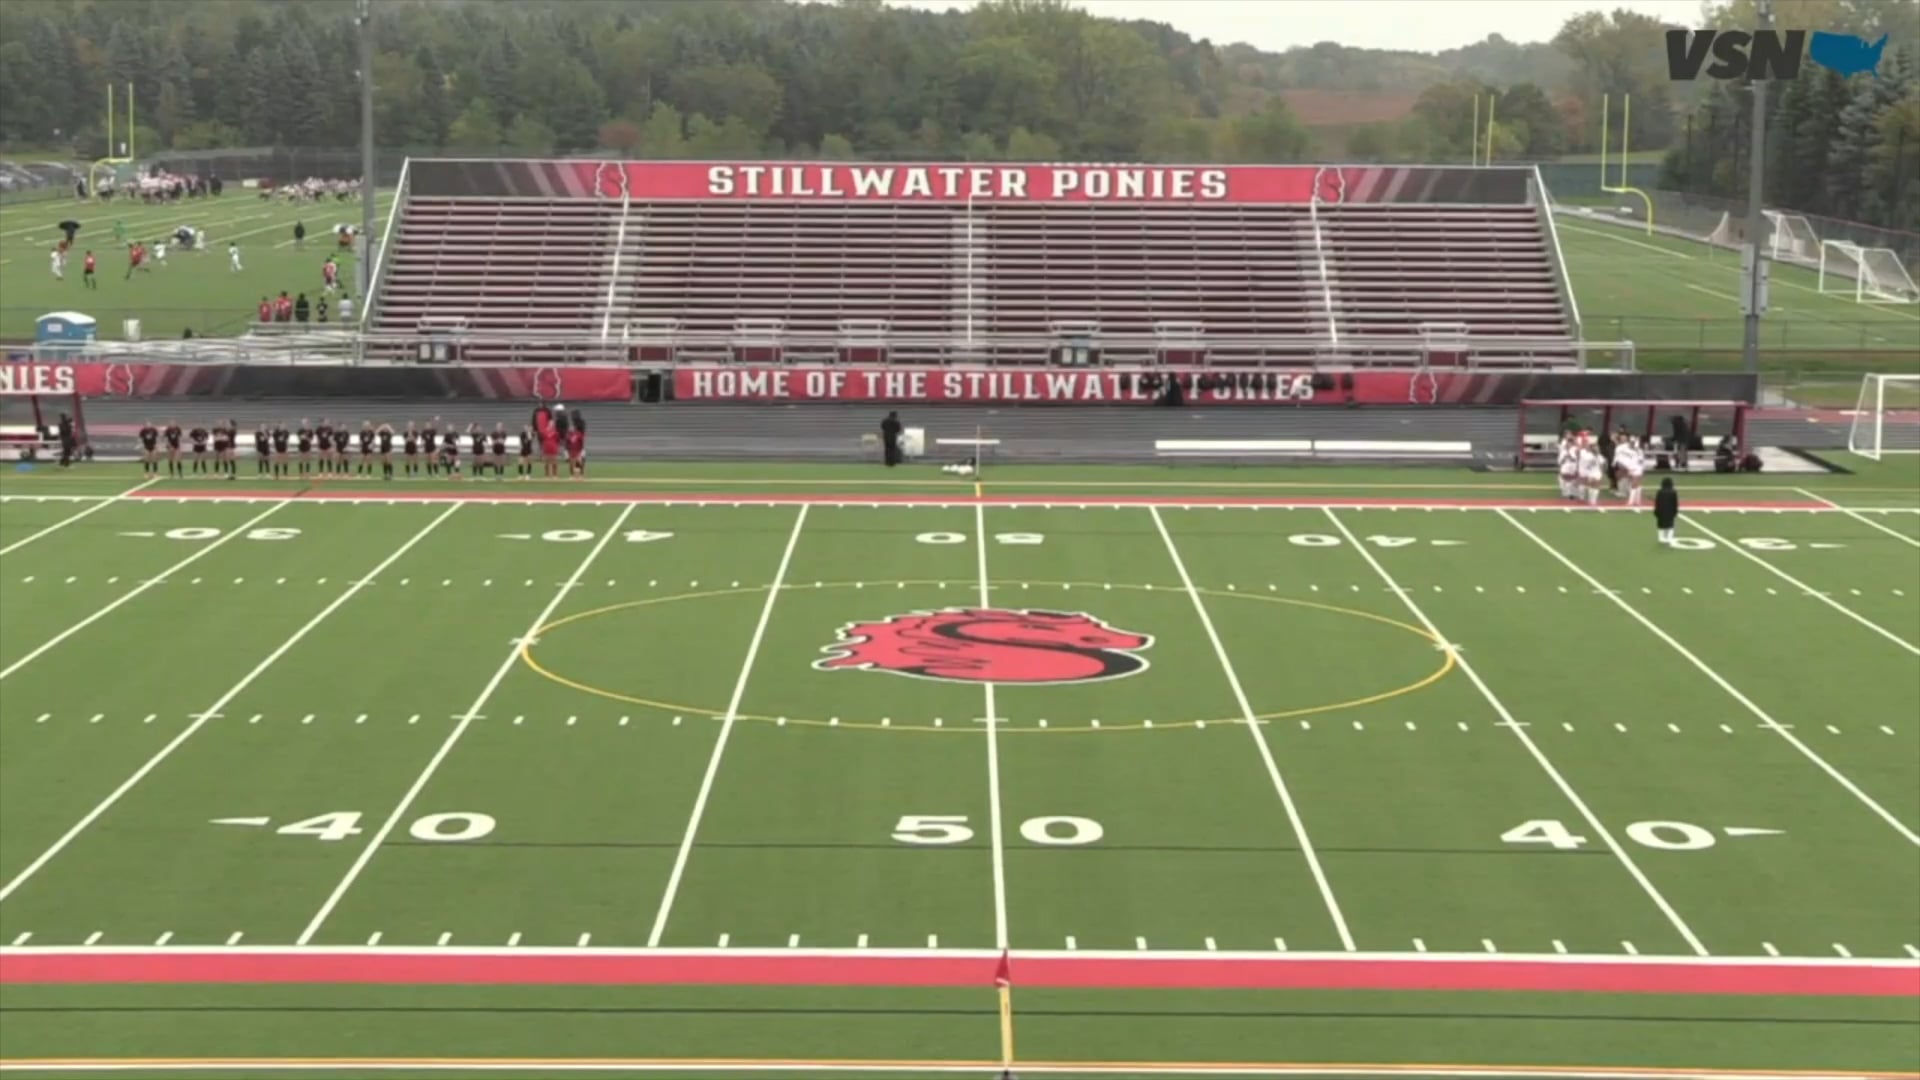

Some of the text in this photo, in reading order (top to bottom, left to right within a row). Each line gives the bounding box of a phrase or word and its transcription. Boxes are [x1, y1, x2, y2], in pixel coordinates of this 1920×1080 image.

[708, 166, 1227, 198] STILLWATER PONIES
[692, 371, 790, 397] HOME
[805, 371, 847, 398] OF
[863, 372, 928, 398] THE
[943, 373, 1171, 400] STILLWATE
[277, 811, 496, 841] 40
[891, 815, 1105, 845] 50
[1501, 820, 1716, 850] 40
